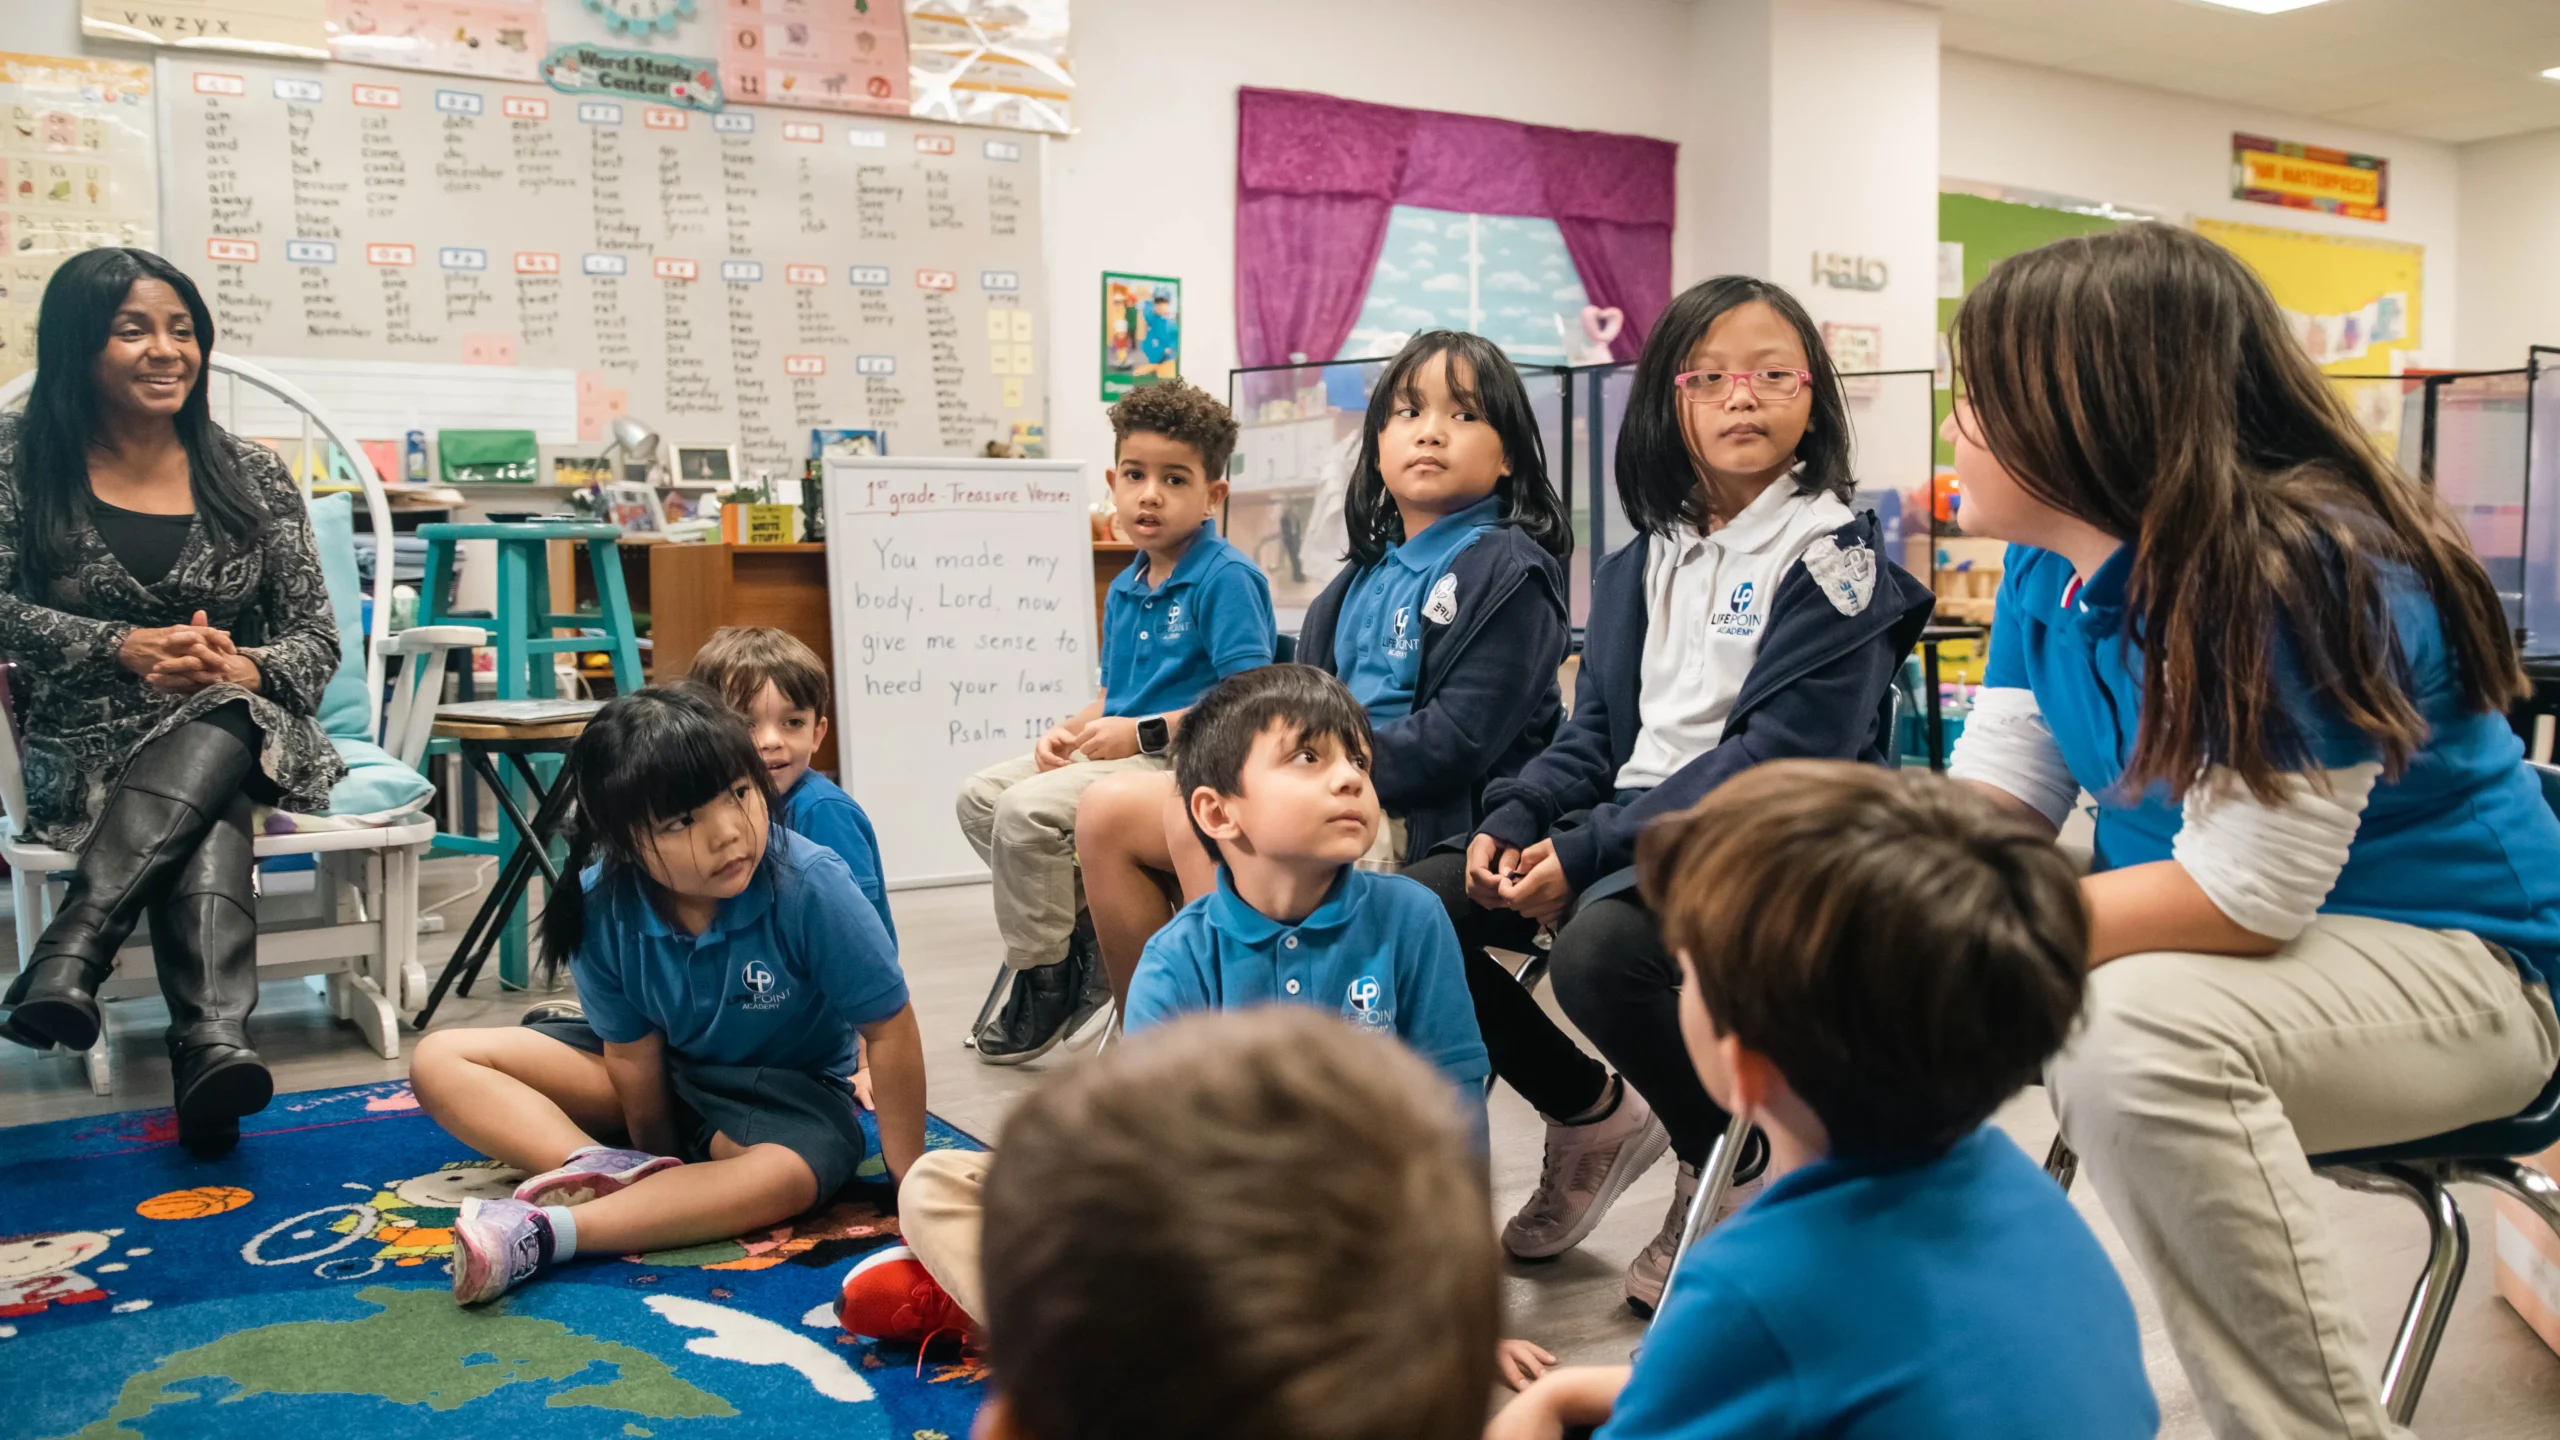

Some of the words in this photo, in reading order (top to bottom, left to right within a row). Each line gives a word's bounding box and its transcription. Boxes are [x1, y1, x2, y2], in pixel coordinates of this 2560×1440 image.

[578, 49, 628, 73] Word
[633, 56, 692, 82] Study
[599, 73, 668, 96] Center
[205, 111, 230, 121] am
[206, 124, 226, 136] at
[206, 138, 238, 150] and
[436, 163, 503, 179] December
[208, 183, 233, 194] all
[213, 221, 262, 235] August
[597, 237, 654, 256] February
[217, 293, 272, 312] Monday
[219, 311, 261, 323] March
[221, 328, 252, 345] May
[308, 325, 372, 337] November
[889, 483, 935, 517] grade
[946, 482, 1019, 504] Treasure
[873, 538, 917, 570] You
[936, 542, 1004, 569] made
[1028, 554, 1059, 582] my
[1017, 596, 1061, 612] now
[1711, 613, 1762, 627] LIFEPOIN
[1717, 627, 1754, 637] ACADEMY
[862, 633, 907, 665] give
[927, 635, 956, 650] me
[975, 634, 1037, 651] sense
[1056, 629, 1079, 653] to
[866, 670, 922, 696] heed
[950, 680, 999, 706] your
[949, 719, 1006, 745] Psalm
[742, 1003, 780, 1011] ACADEMY
